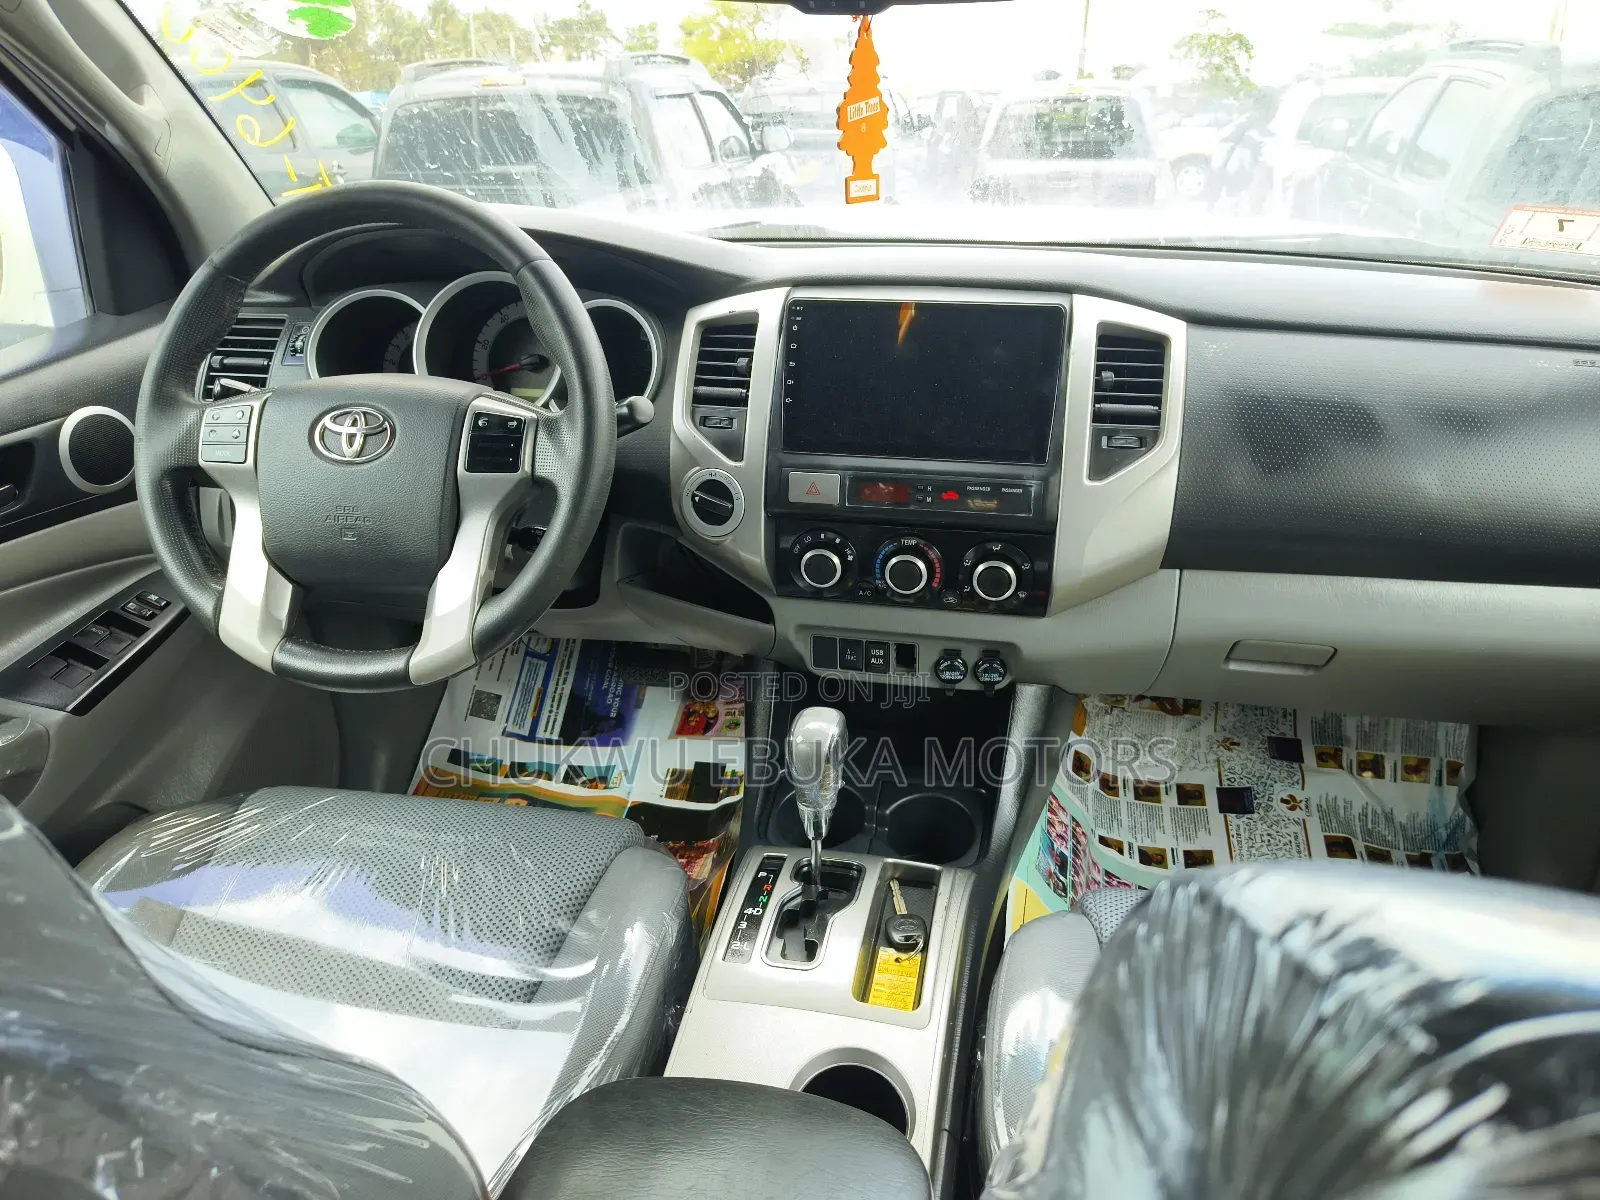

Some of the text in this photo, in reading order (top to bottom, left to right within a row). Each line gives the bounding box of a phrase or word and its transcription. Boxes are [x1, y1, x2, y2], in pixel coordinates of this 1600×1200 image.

[849, 104, 864, 120] Little
[501, 314, 510, 324] 40
[481, 339, 490, 351] 20
[803, 535, 812, 544] LO
[900, 538, 918, 546] TEMP
